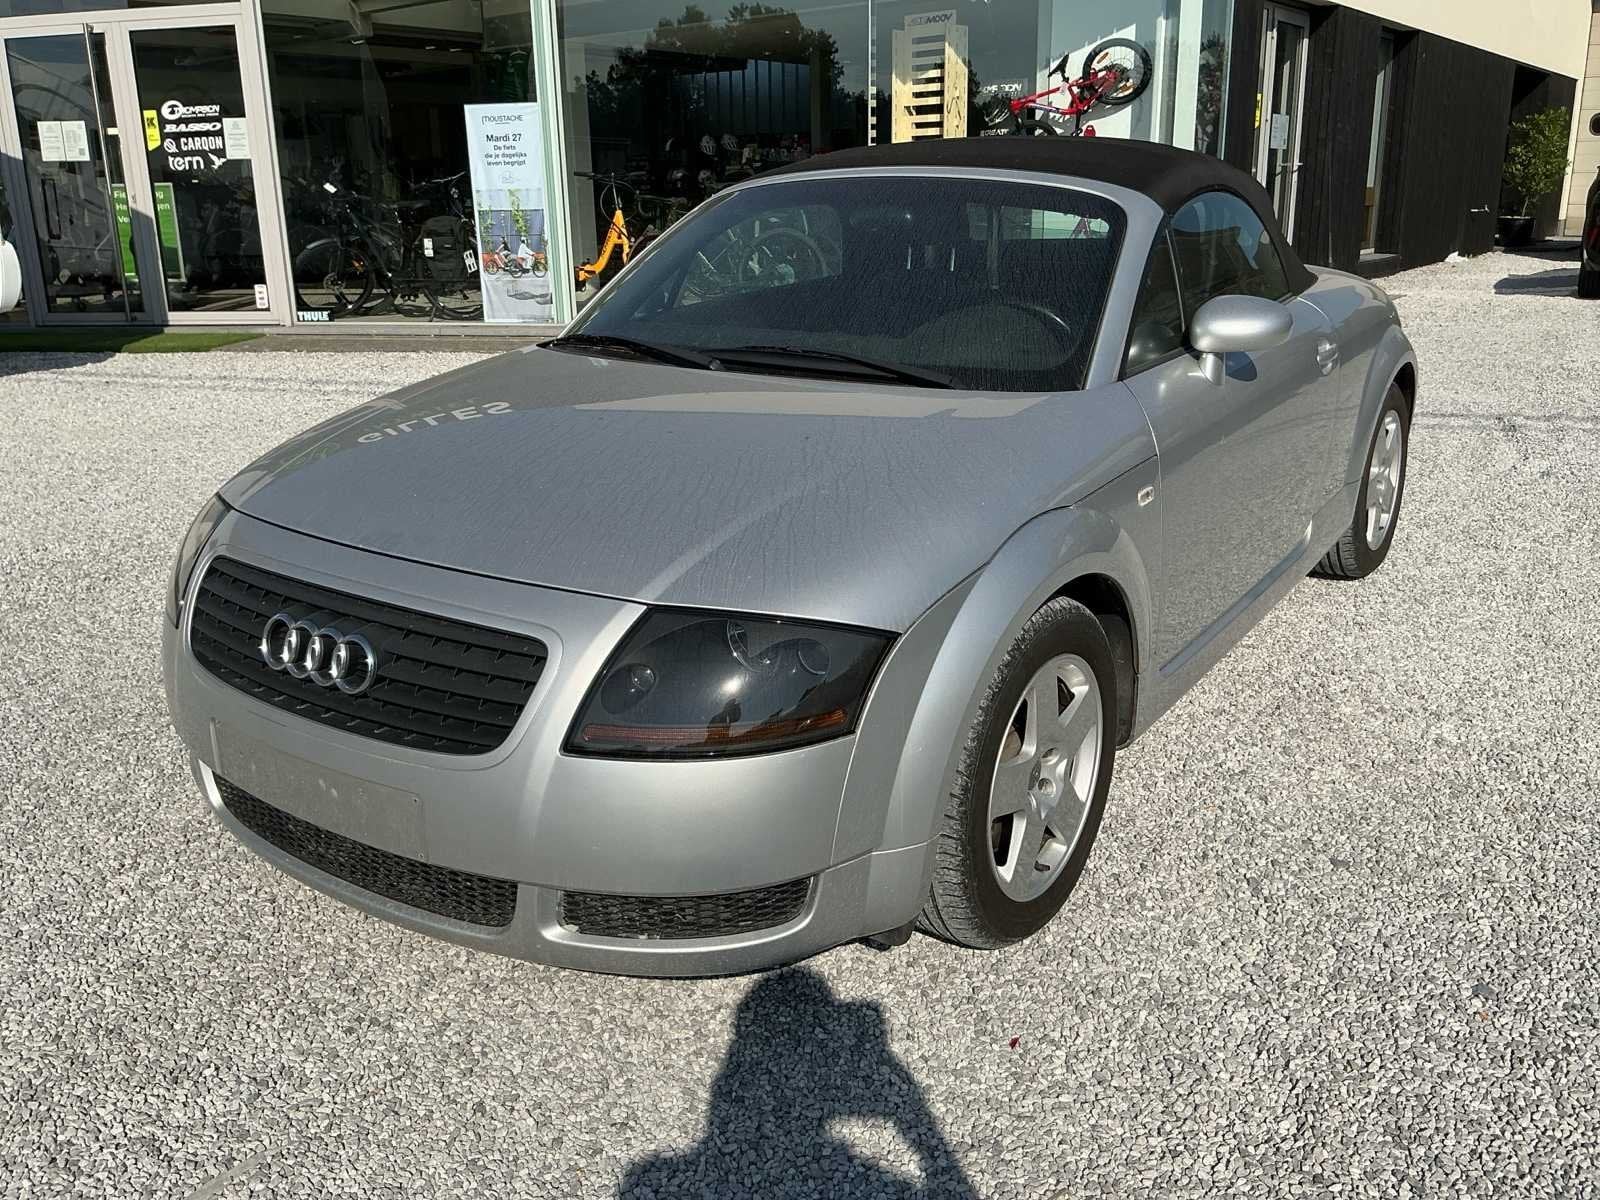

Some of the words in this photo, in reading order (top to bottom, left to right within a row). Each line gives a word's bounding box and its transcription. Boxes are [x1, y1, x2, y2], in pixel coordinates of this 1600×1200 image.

[164, 122, 222, 133] BASSO
[180, 136, 224, 151] CARQON
[486, 134, 510, 142] Mardi
[512, 134, 522, 142] 27
[168, 156, 204, 170] tern
[297, 311, 330, 322] THULE
